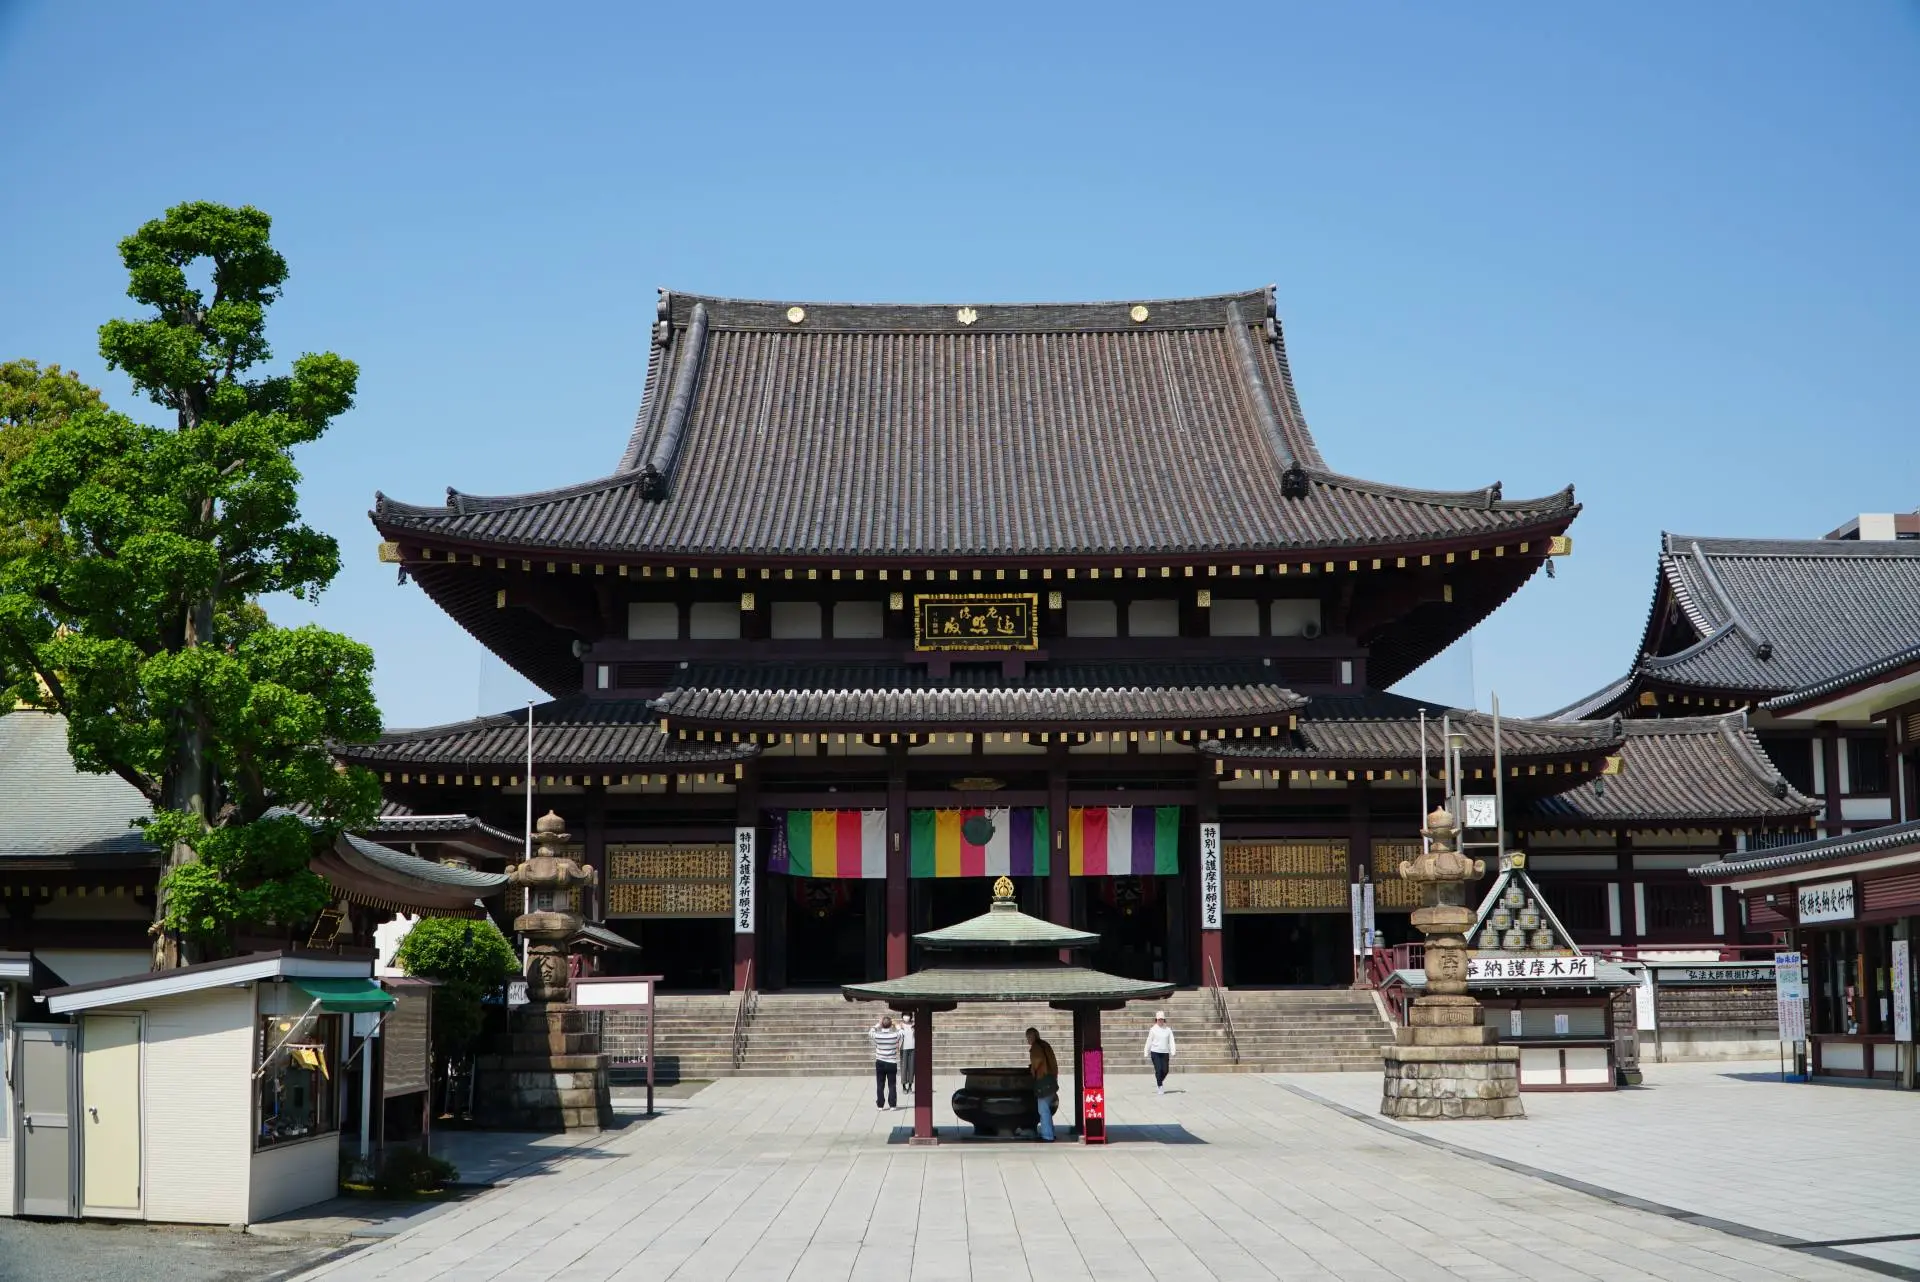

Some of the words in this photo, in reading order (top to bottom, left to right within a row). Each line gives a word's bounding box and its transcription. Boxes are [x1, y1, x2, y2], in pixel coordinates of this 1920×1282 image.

[739, 832, 751, 929] 特別大護摩祈願芳名
[1204, 827, 1217, 924] 特別大護摩祈願芳名
[1776, 954, 1799, 964] 御朱印
